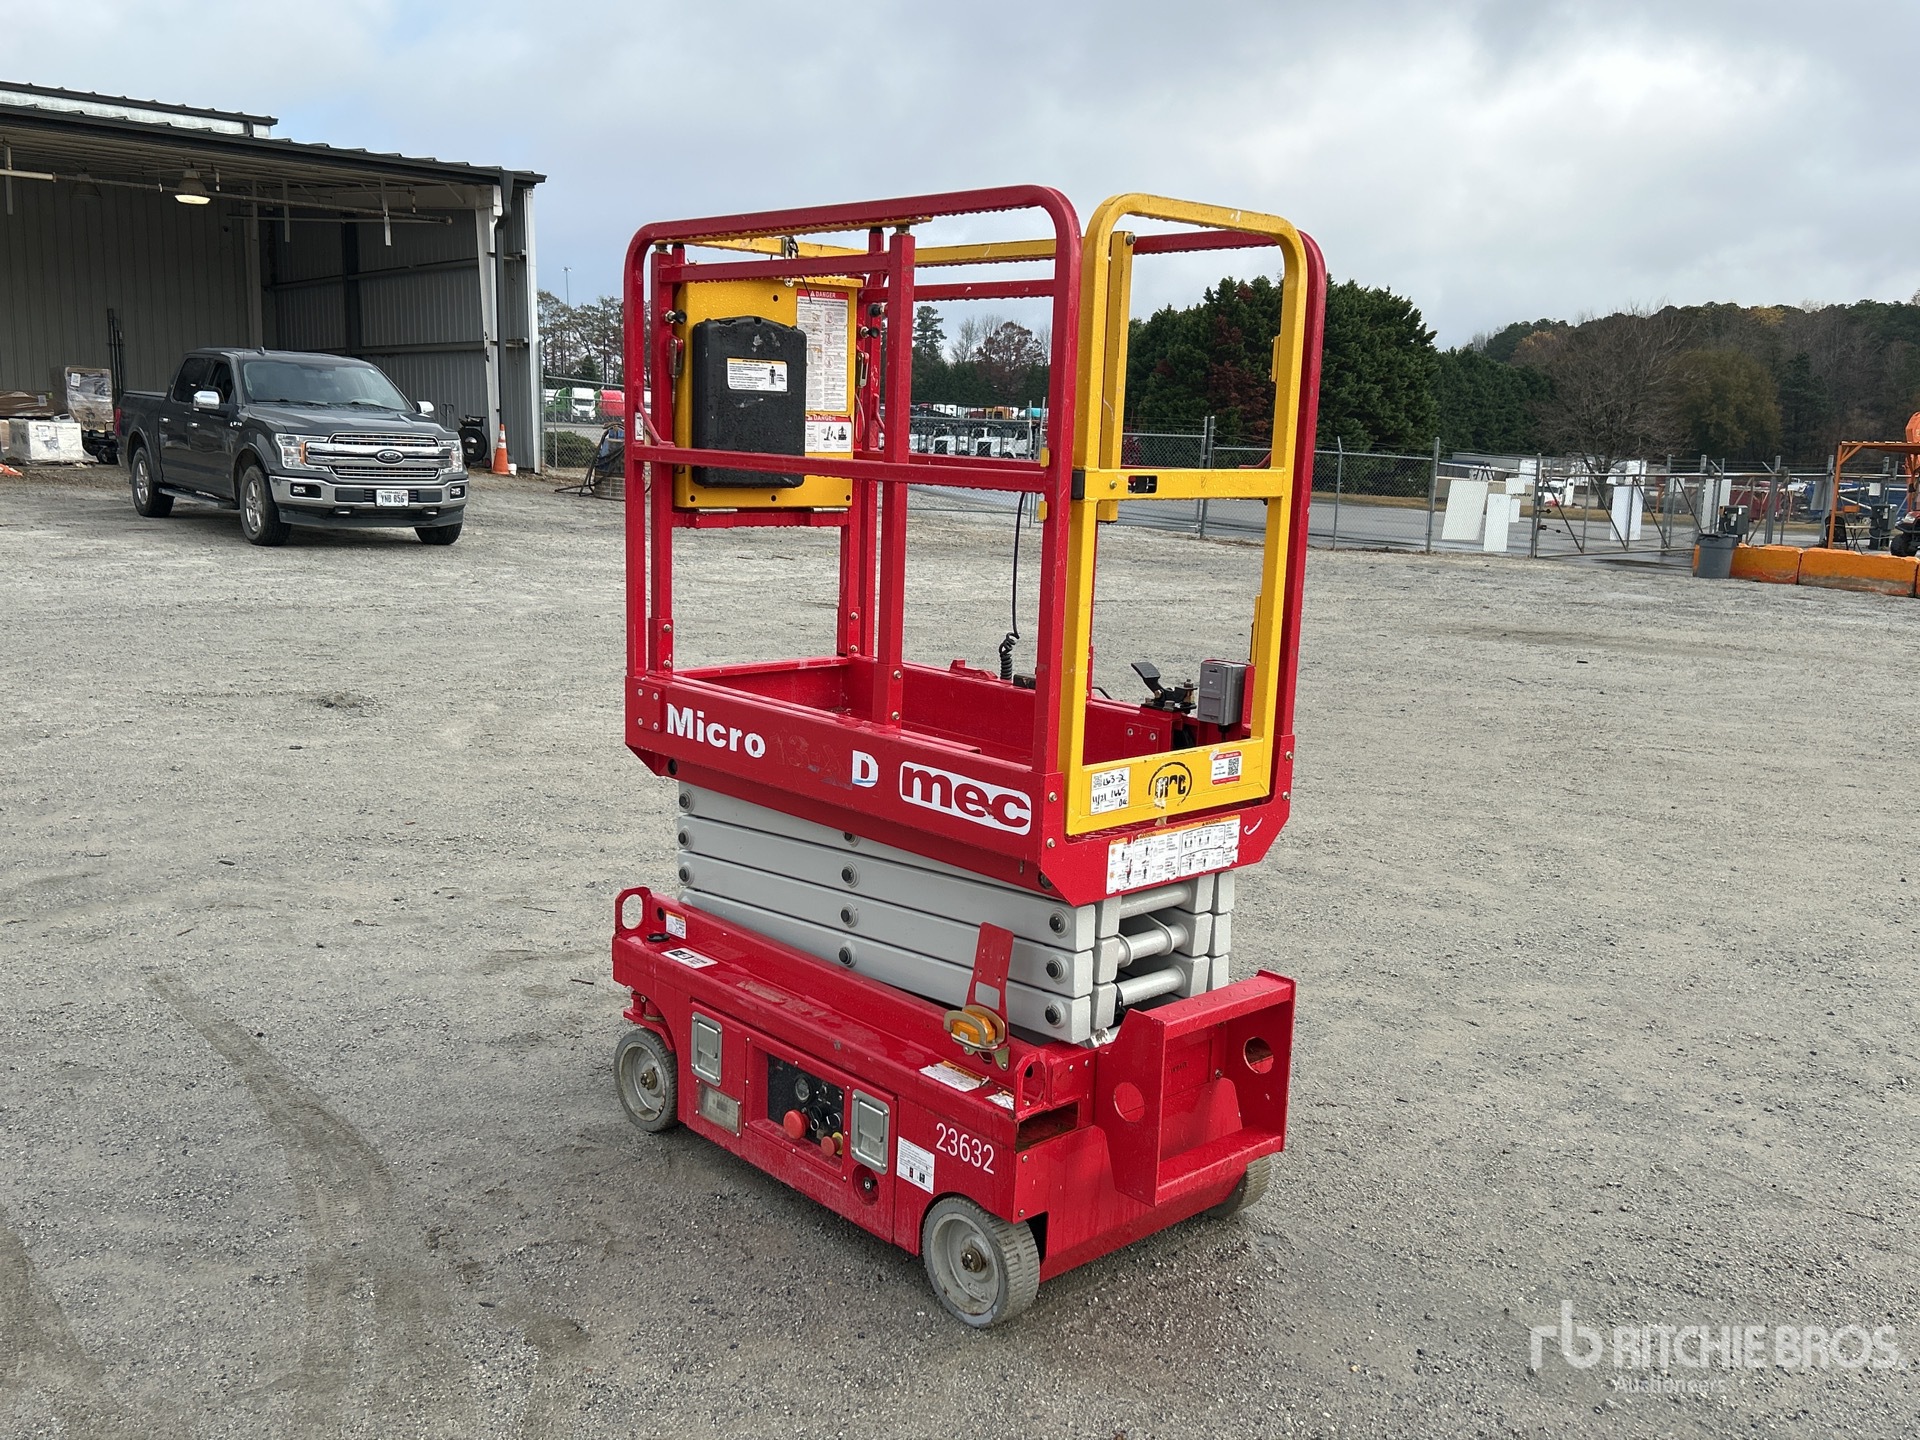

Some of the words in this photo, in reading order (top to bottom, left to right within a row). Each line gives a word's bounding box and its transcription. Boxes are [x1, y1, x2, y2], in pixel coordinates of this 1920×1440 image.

[667, 703, 766, 758] Micro
[901, 765, 1030, 829] mec
[935, 1122, 995, 1175] 23632
